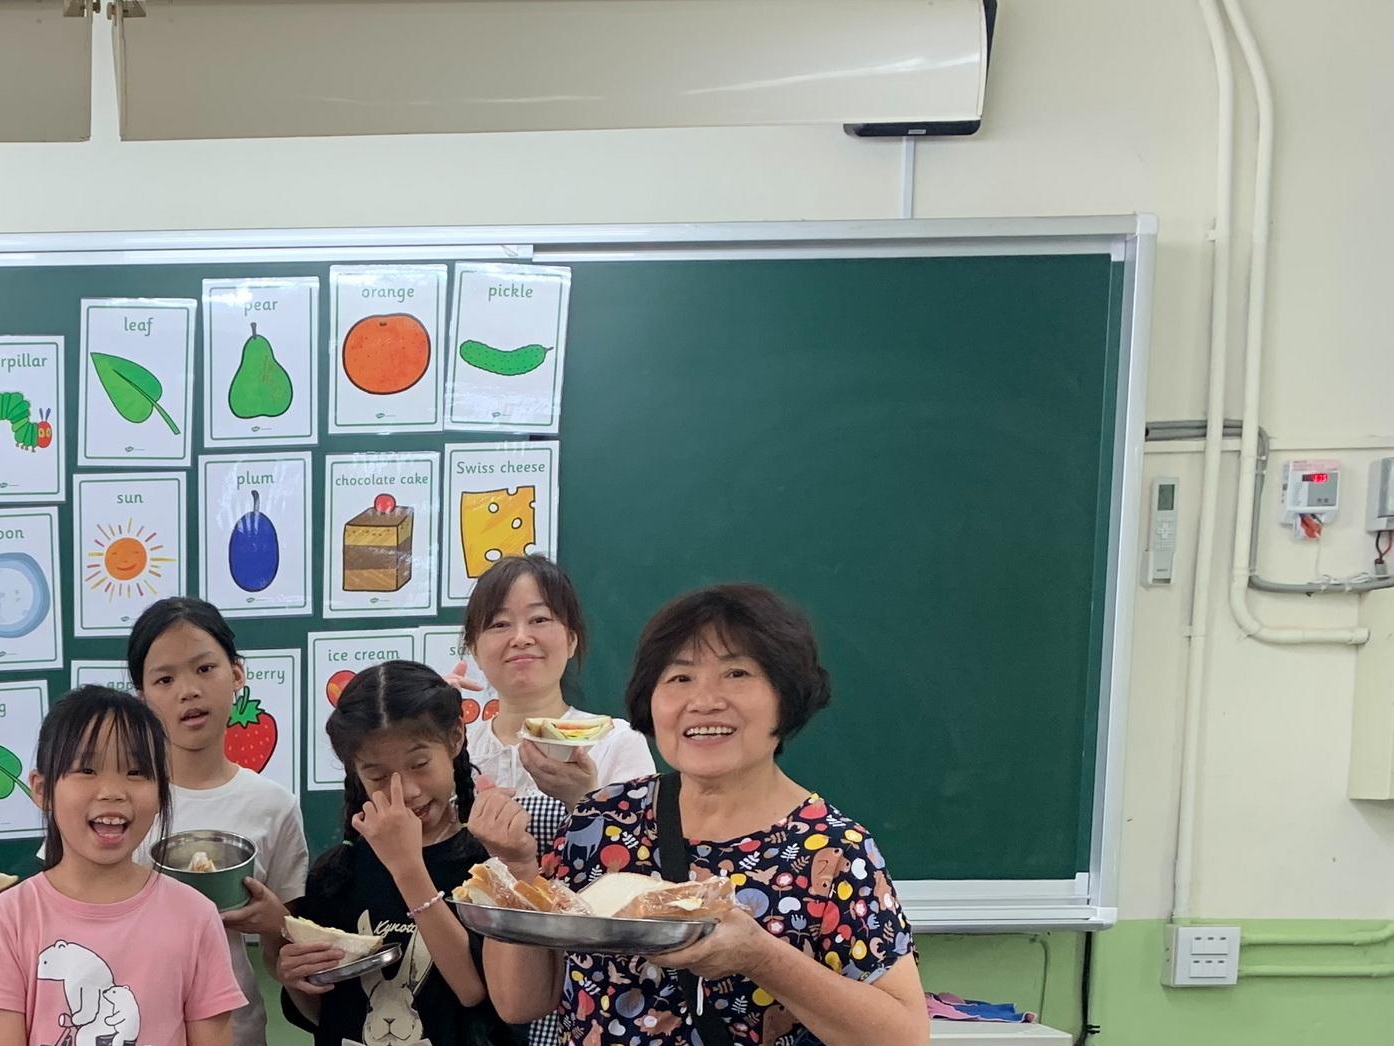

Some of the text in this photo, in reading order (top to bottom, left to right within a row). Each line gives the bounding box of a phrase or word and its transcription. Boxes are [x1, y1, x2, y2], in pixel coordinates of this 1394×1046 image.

[361, 286, 415, 302] orange
[488, 282, 534, 302] pickle
[243, 299, 279, 317] pear
[124, 316, 155, 337] leaf
[456, 460, 546, 475] Swiss cheese
[236, 470, 275, 490] plum
[335, 471, 429, 487] chocolate cake
[116, 493, 144, 505] sun
[327, 648, 401, 662] ice cream
